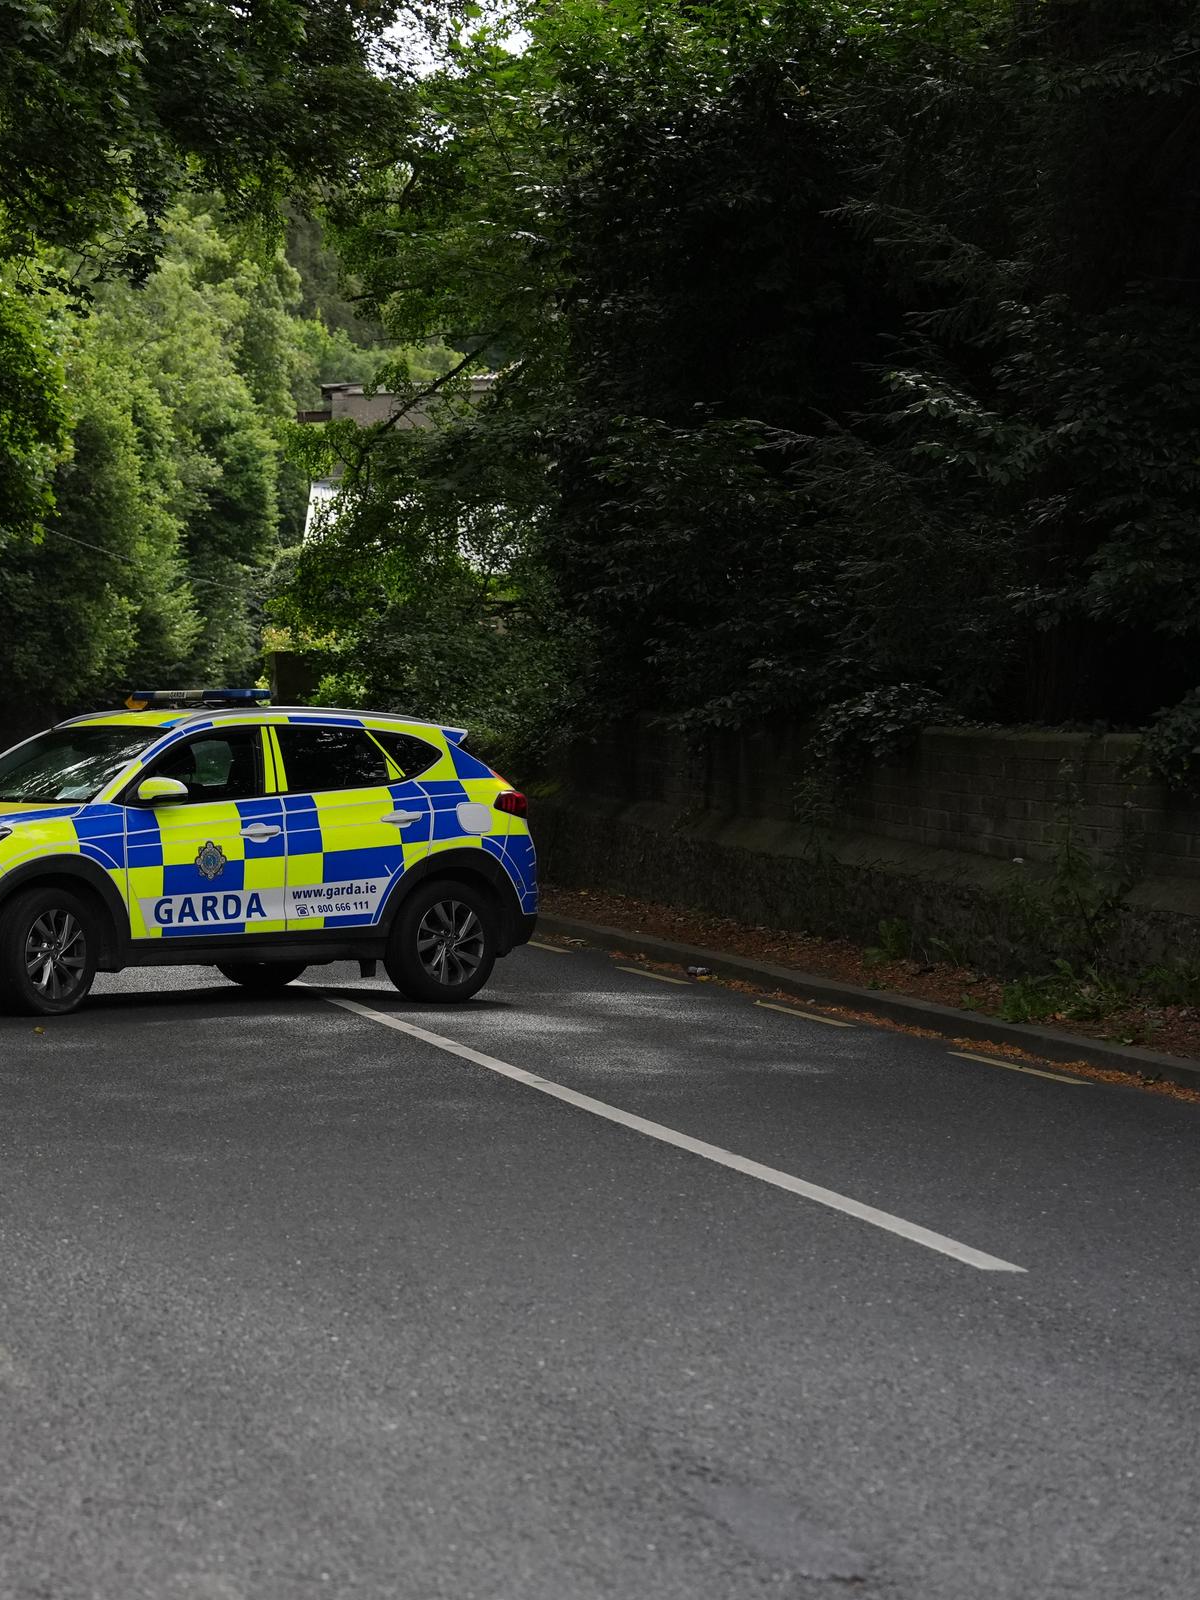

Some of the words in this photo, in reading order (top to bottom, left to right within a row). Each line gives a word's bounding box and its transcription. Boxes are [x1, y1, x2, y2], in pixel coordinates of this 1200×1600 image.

[292, 882, 377, 899] www.garda.ie
[154, 892, 267, 925] GARDA
[310, 905, 315, 914] 1
[317, 903, 333, 913] 800
[335, 902, 351, 912] 666
[353, 900, 369, 910] 111
